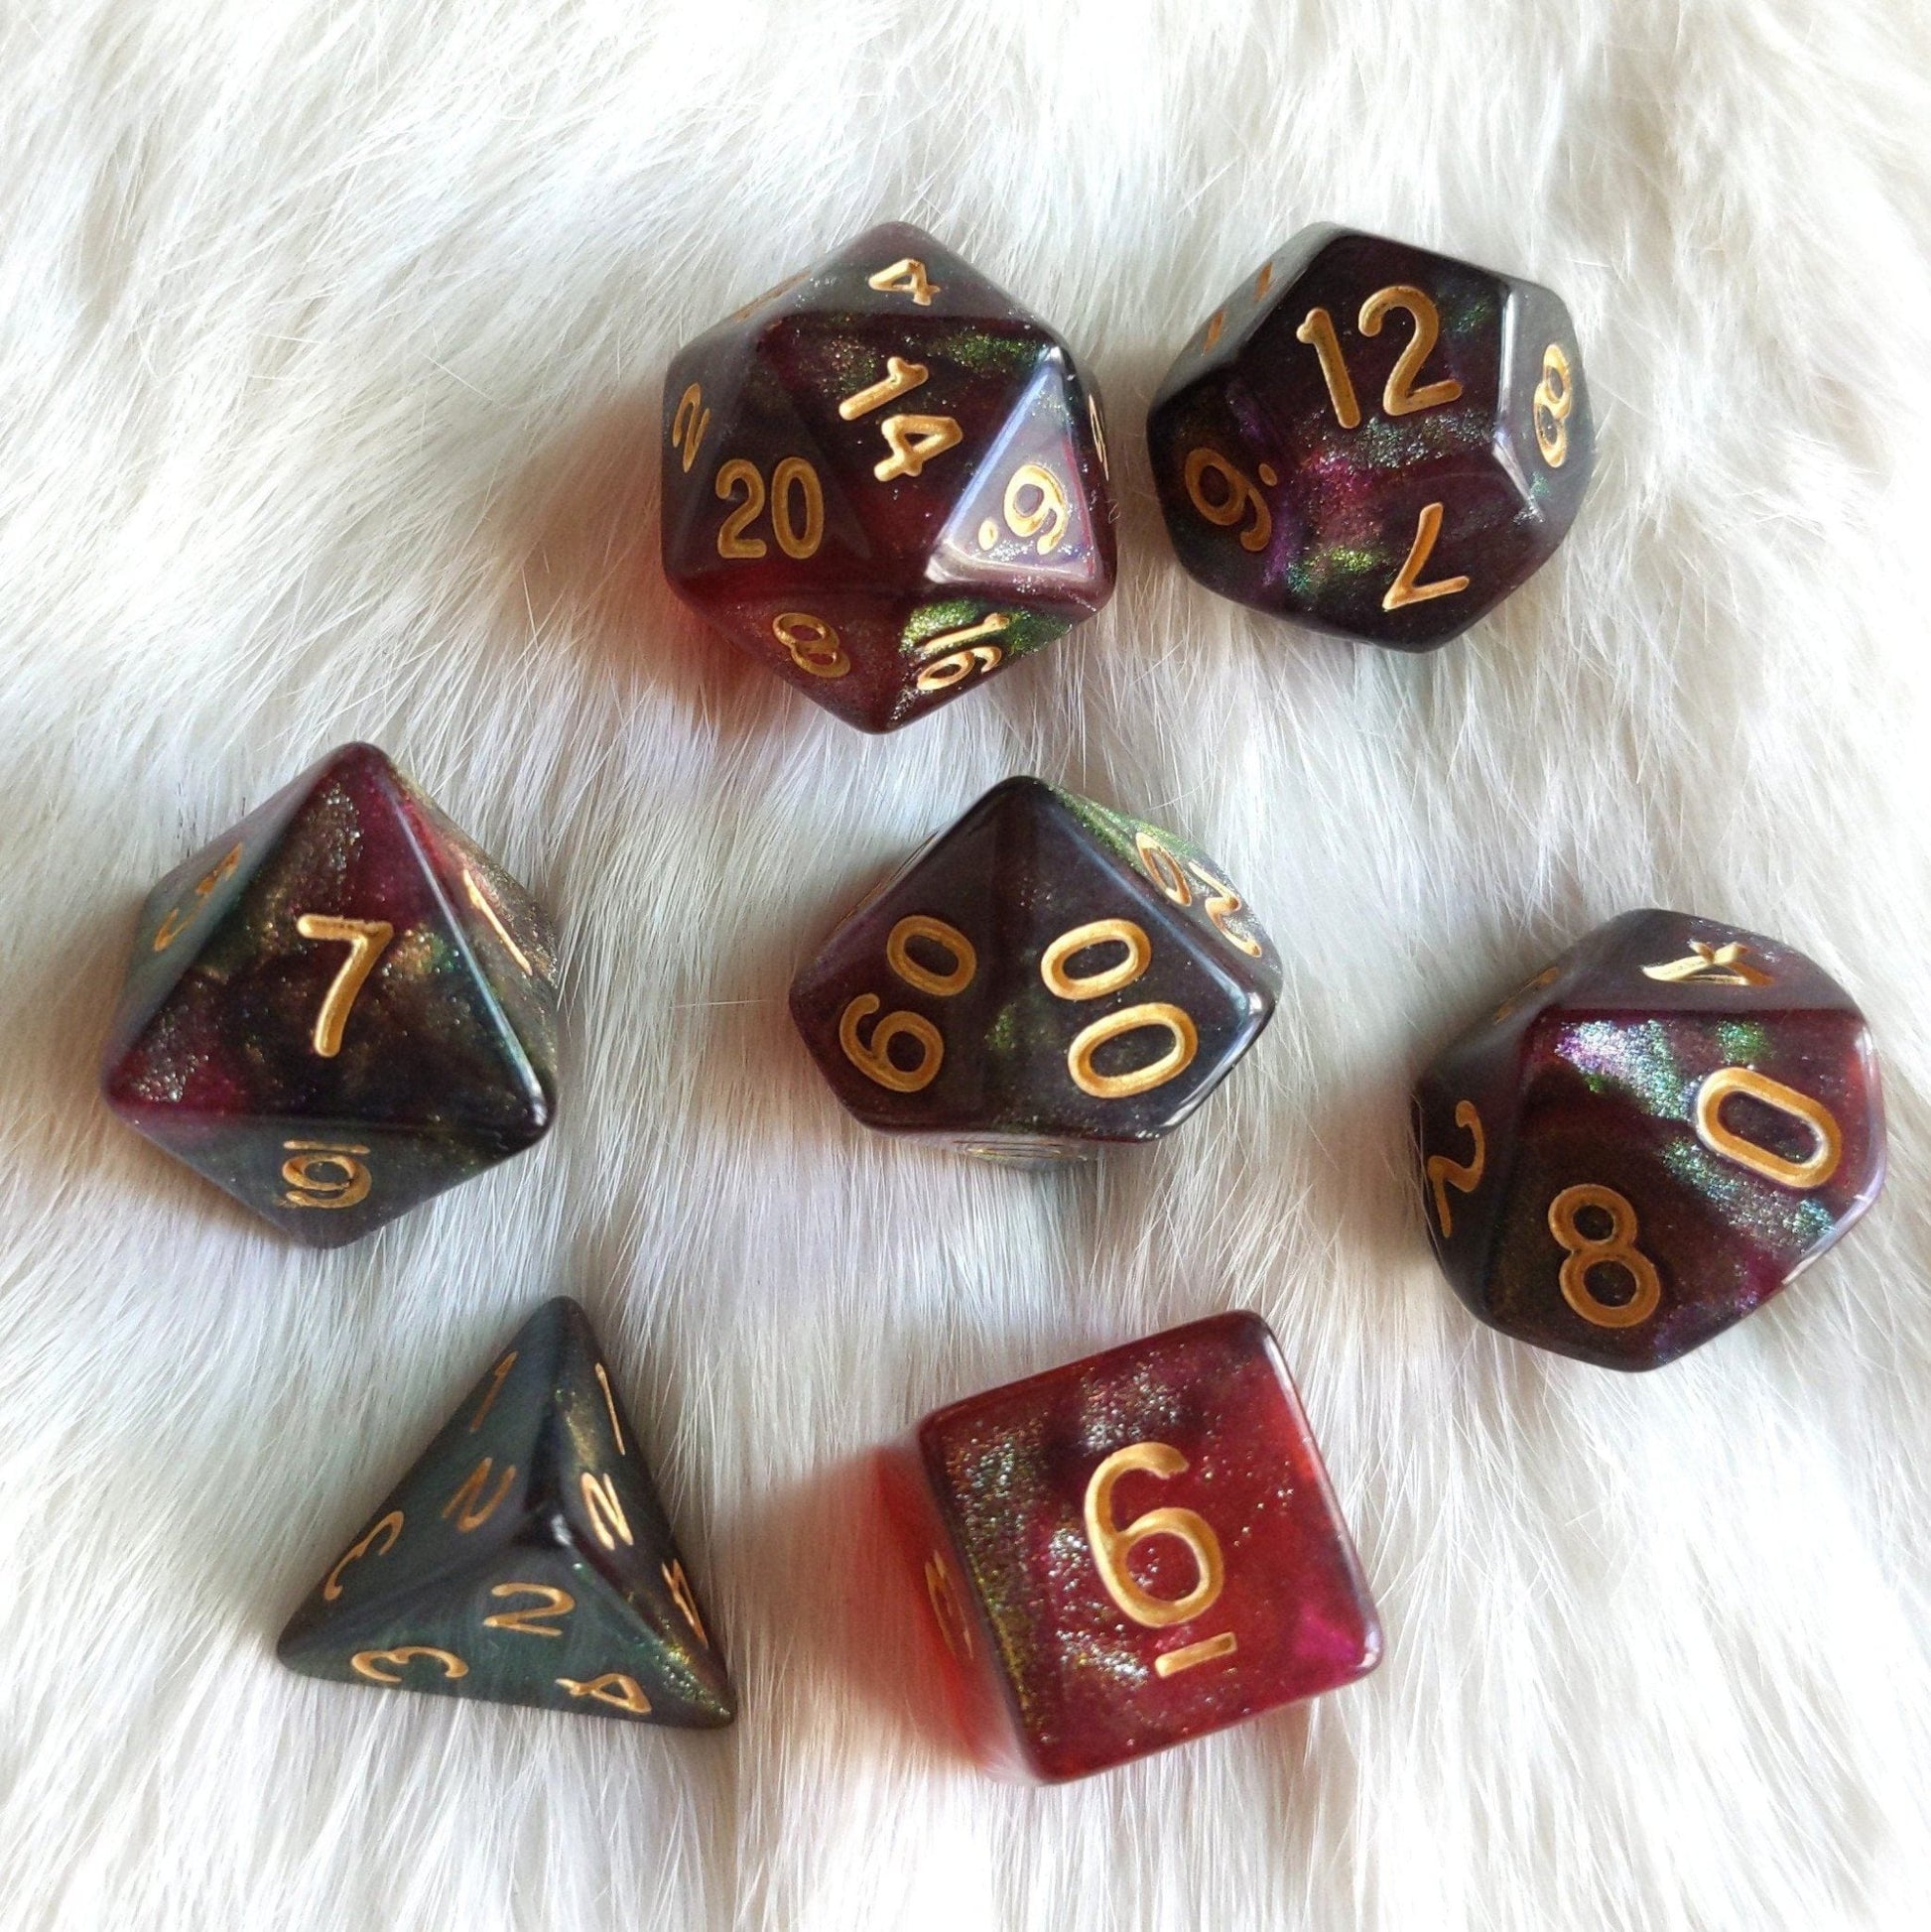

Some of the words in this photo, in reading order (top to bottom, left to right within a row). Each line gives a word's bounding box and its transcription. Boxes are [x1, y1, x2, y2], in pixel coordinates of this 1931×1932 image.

[869, 258, 941, 306] 4
[838, 356, 964, 482] 14
[1296, 285, 1464, 430] 12
[1533, 343, 1573, 468] 8
[715, 456, 824, 559] 20
[1382, 501, 1470, 610] 7
[772, 612, 851, 678] 8
[915, 611, 1010, 692] 16
[1135, 832, 1263, 958] 20
[298, 913, 394, 1059] 7
[838, 914, 978, 1094] 60
[1040, 917, 1199, 1099] 00
[1426, 1099, 1486, 1239] 2
[1696, 1066, 1842, 1190] 0
[1547, 1183, 1661, 1330] 8
[351, 1645, 469, 1683] 3
[483, 1582, 577, 1637] 2
[556, 1673, 653, 1715] 4
